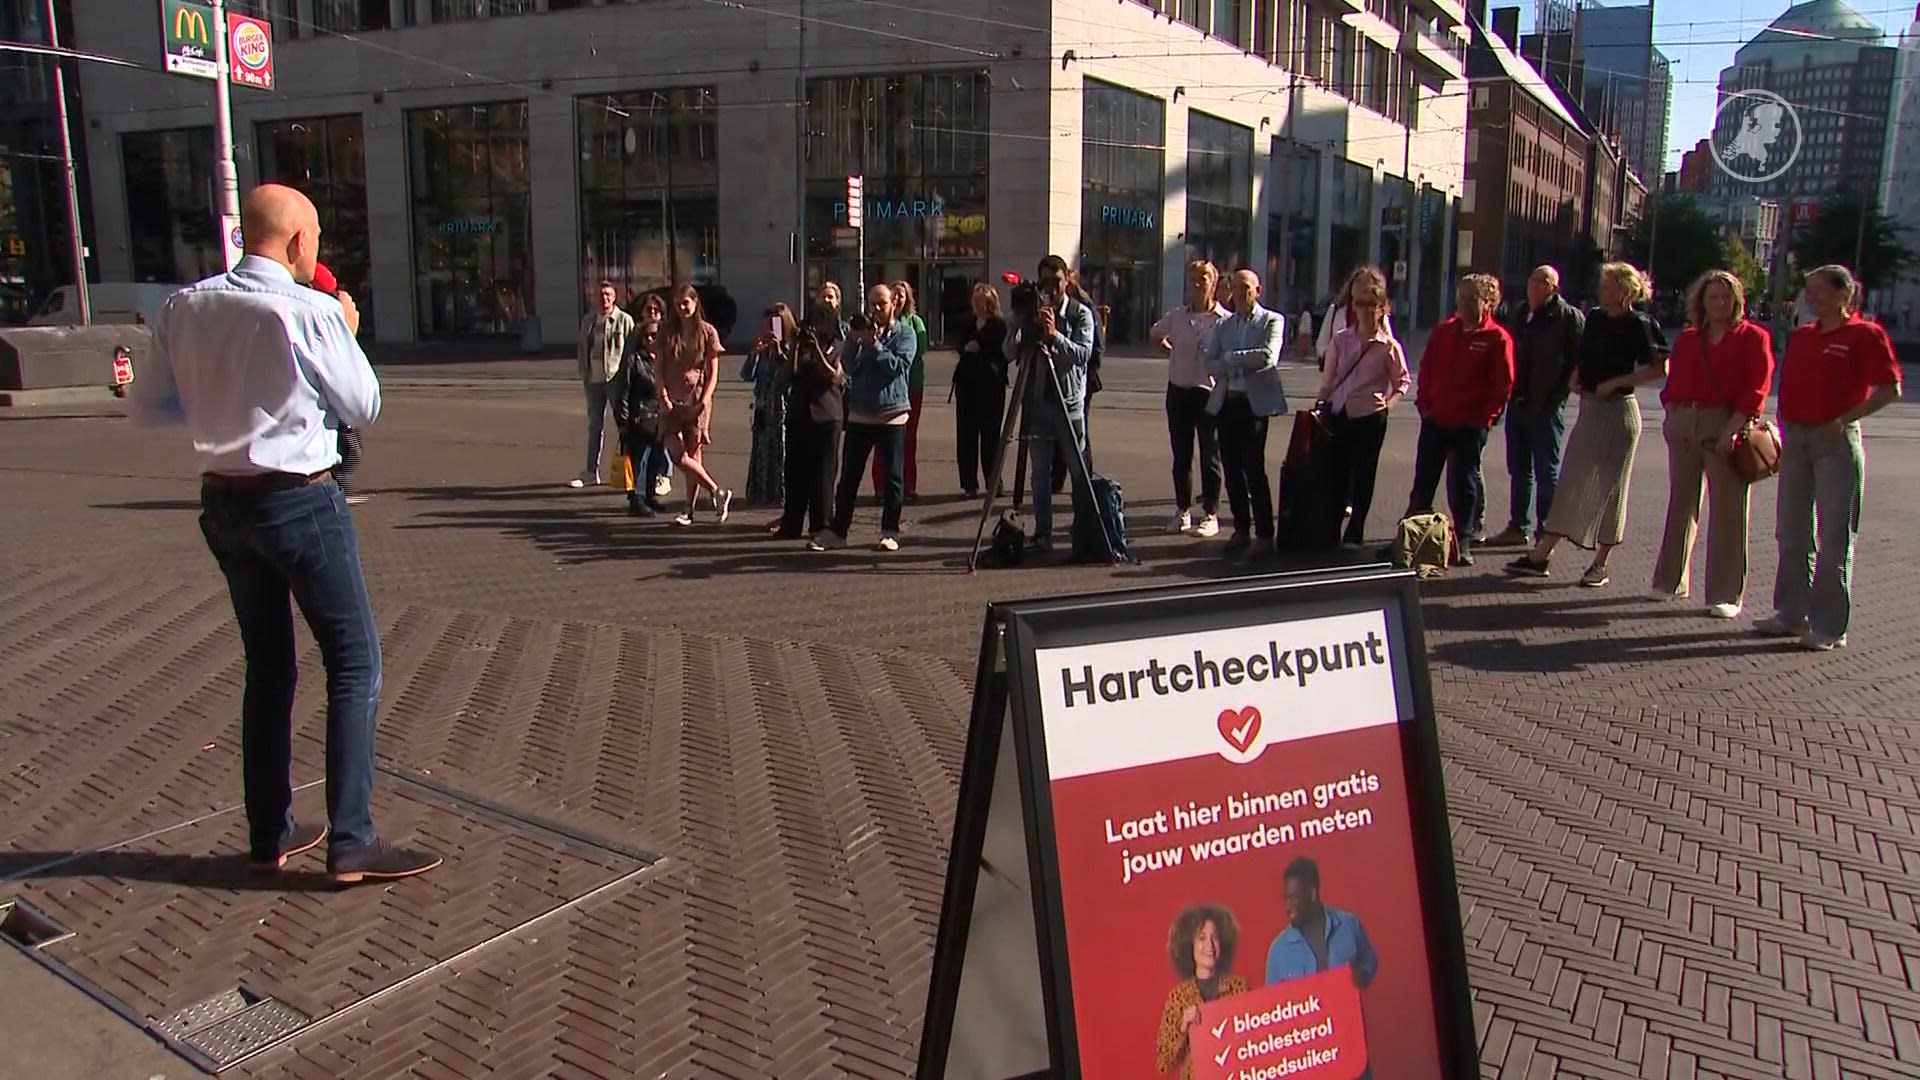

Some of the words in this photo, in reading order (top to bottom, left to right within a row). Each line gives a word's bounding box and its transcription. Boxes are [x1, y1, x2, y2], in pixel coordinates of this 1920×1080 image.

[239, 33, 263, 44] BURGER
[241, 42, 265, 56] KING
[833, 200, 945, 218] PIMARK
[1103, 205, 1153, 229] PRIMARK
[440, 222, 497, 233] PRIMARK
[1061, 631, 1385, 708] Hartcheckpunt
[1105, 810, 1169, 844] Laat
[1173, 801, 1222, 831] hier
[1227, 791, 1308, 821] binnen
[1312, 769, 1380, 809] gratis
[1121, 846, 1184, 884] jouw
[1189, 823, 1295, 862] waarden
[1300, 807, 1372, 839] meten
[1233, 995, 1321, 1033] bloeddruk
[1237, 1017, 1333, 1060] cholesterol
[1239, 1047, 1339, 1080] bloedsuiker
